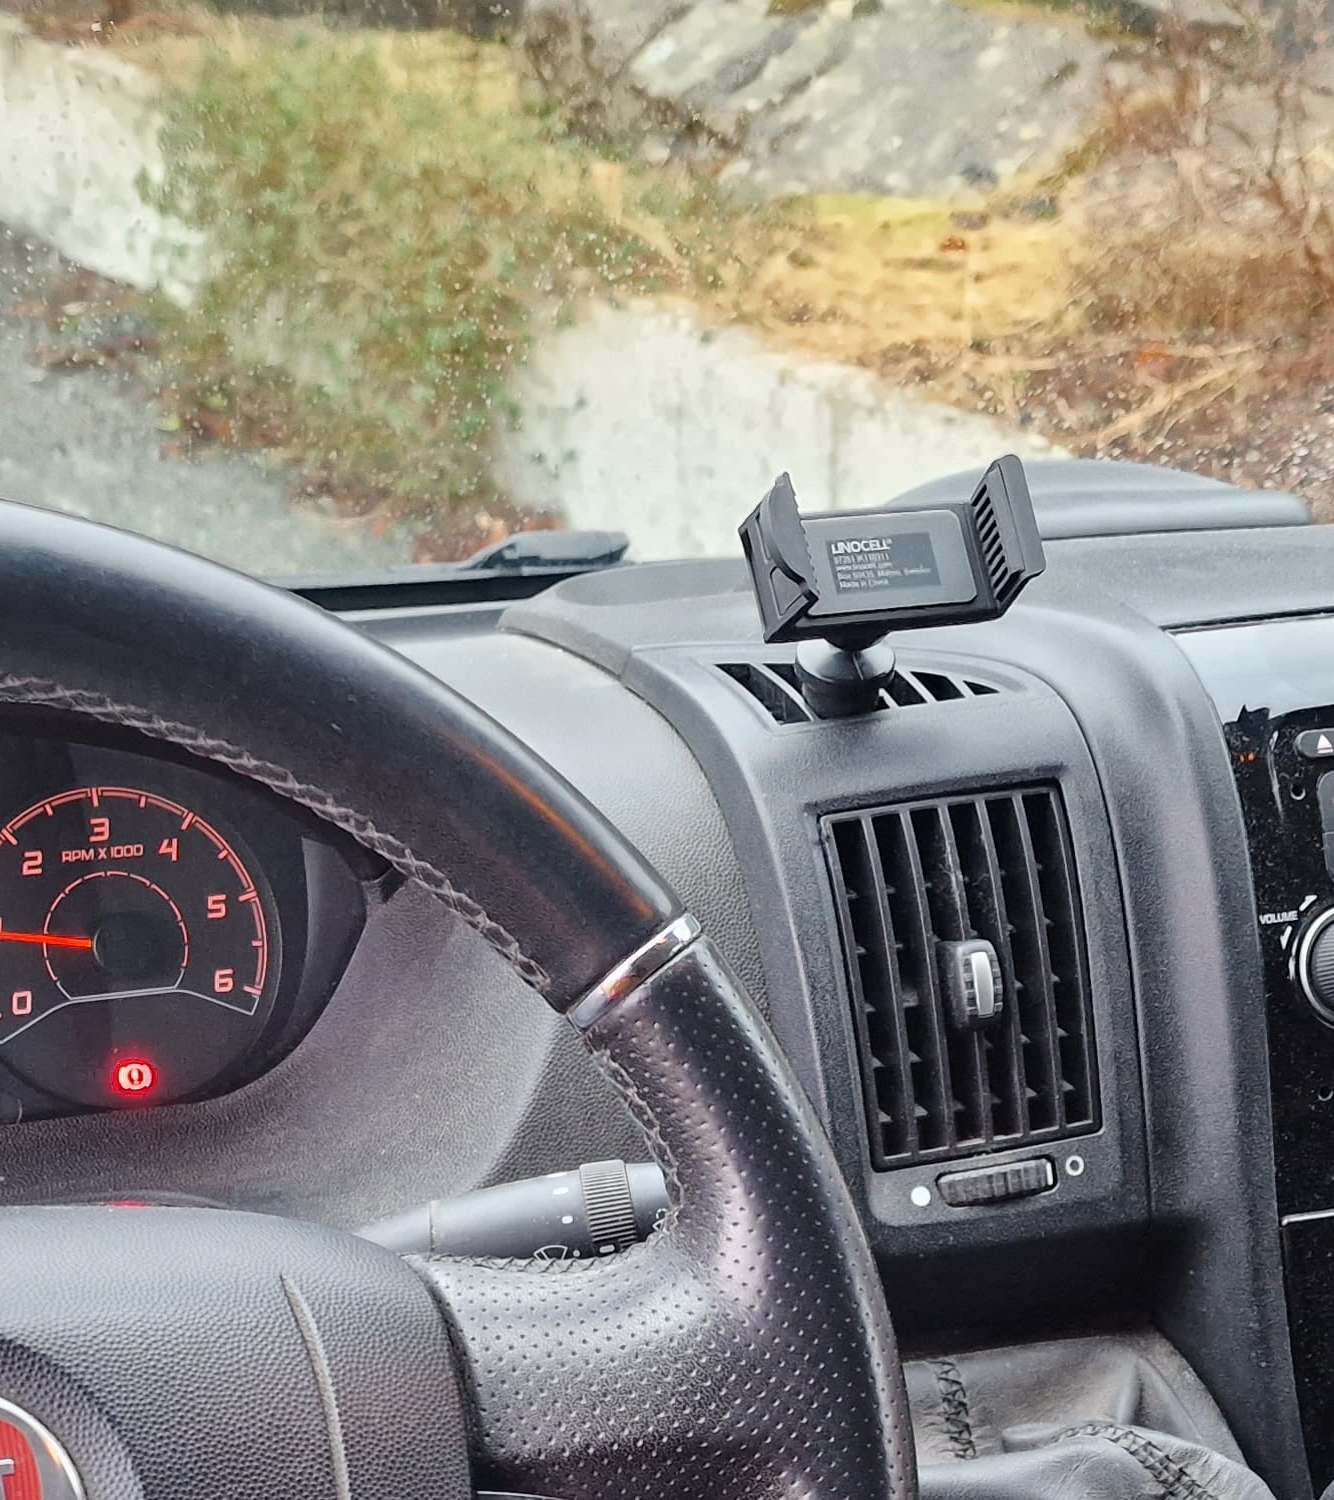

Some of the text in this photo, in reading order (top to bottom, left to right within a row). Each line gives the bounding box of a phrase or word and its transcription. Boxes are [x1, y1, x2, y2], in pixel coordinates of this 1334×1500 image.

[89, 817, 110, 842] 3
[62, 848, 94, 863] RPM
[110, 844, 143, 859] 1000
[158, 838, 178, 861] 4
[22, 851, 43, 876] 2
[207, 894, 226, 919] 5
[1259, 910, 1299, 925] VOLUME
[214, 968, 234, 993] 6
[12, 991, 32, 1015] 0
